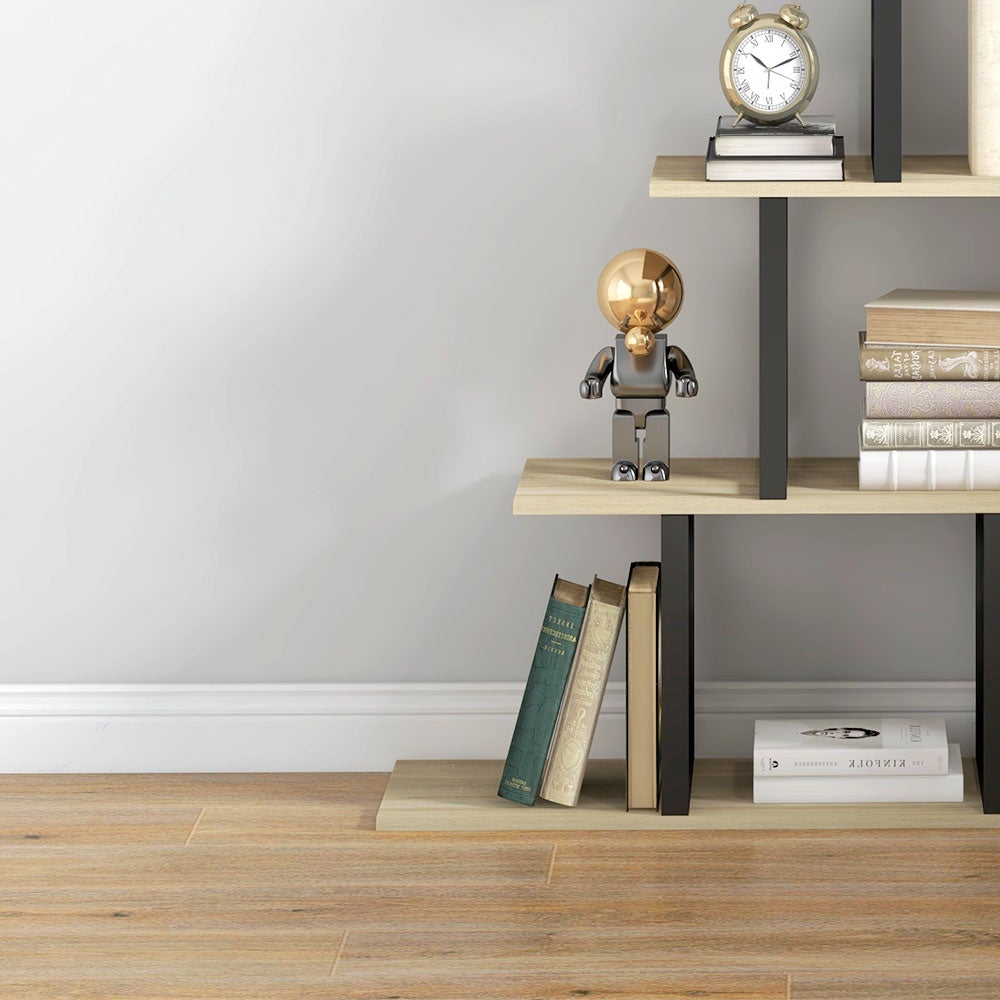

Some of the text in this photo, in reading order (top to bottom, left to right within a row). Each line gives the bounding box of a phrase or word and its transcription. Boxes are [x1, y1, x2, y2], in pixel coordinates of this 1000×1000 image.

[765, 35, 773, 43] XII
[781, 39, 786, 47] I
[751, 39, 759, 48] XI
[737, 67, 745, 75] IX
[741, 79, 751, 92] VIII
[751, 92, 760, 103] VII
[779, 92, 786, 100] V
[765, 97, 773, 105] VI
